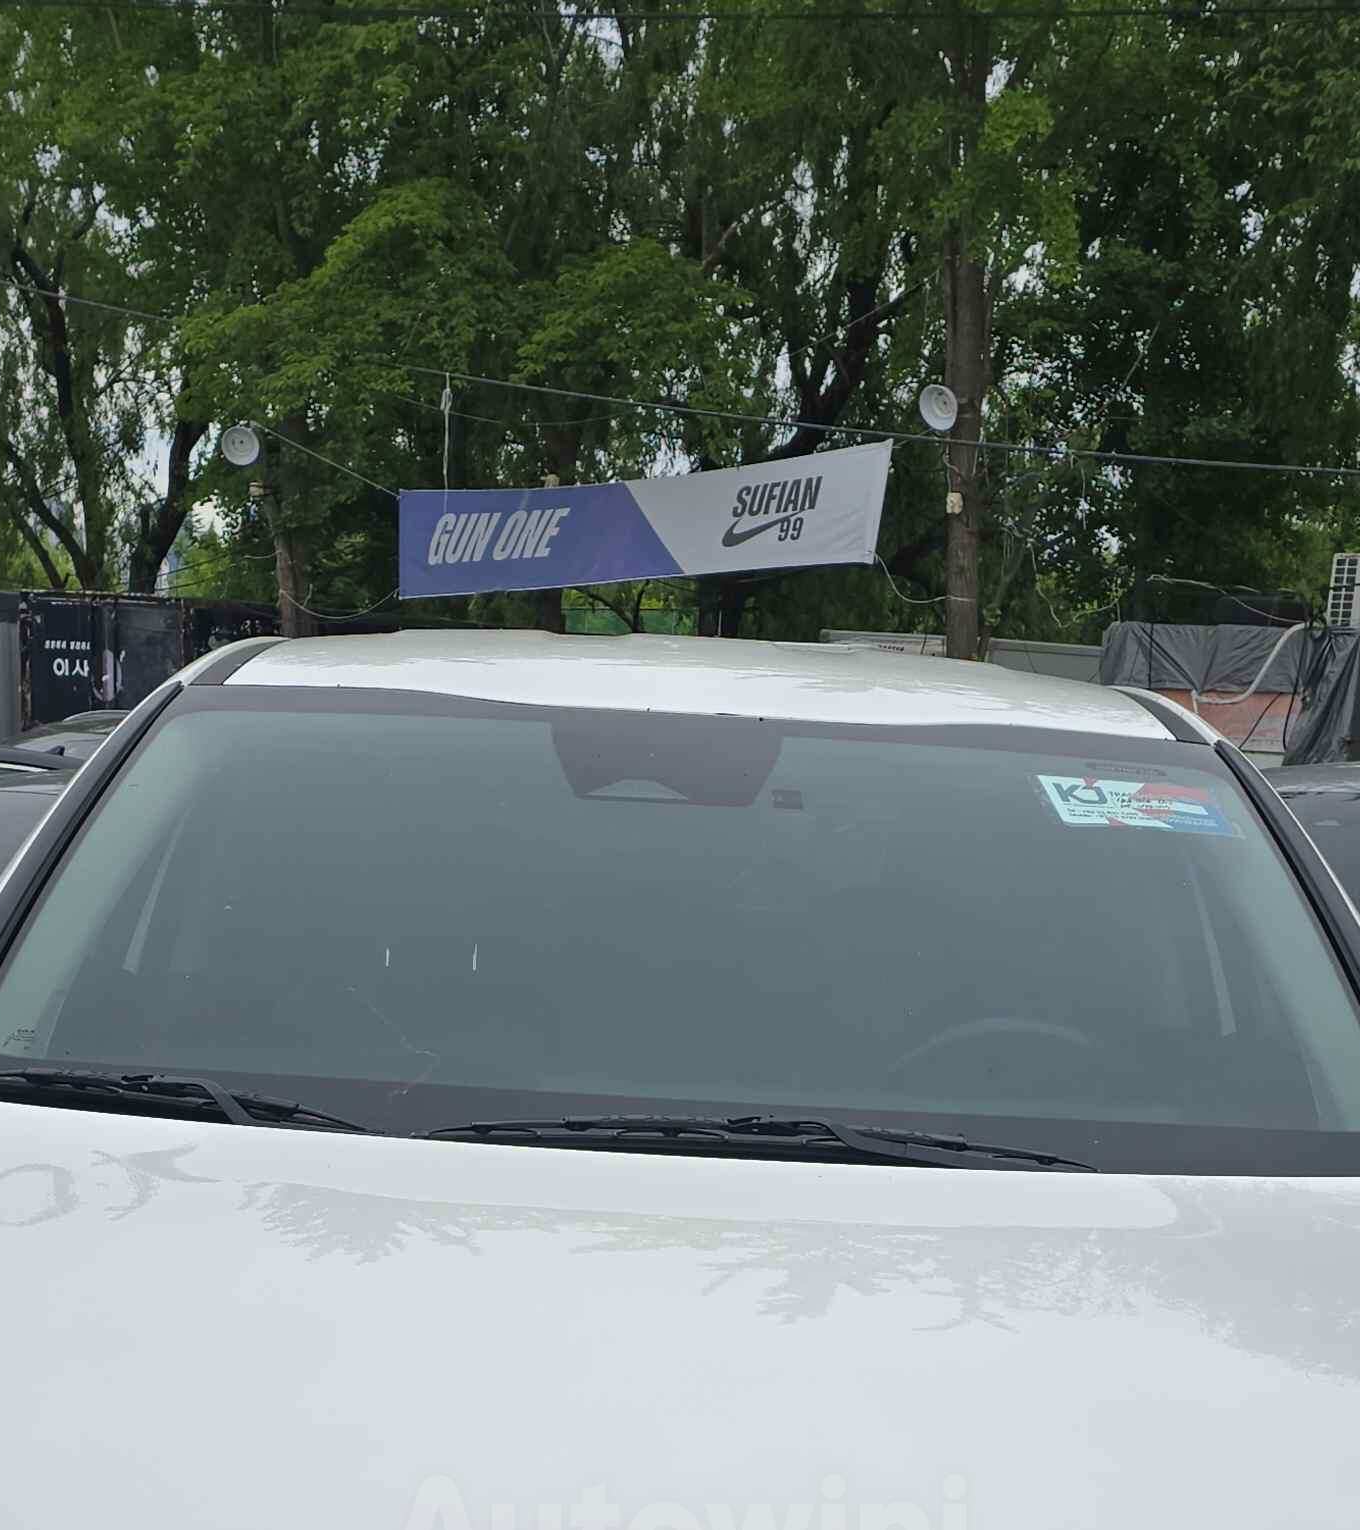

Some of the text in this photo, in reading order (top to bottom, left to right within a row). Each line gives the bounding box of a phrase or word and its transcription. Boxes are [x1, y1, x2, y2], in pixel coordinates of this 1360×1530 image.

[731, 475, 823, 519] SUFIAN
[427, 507, 571, 566] GUN ONE
[777, 517, 805, 542] 99
